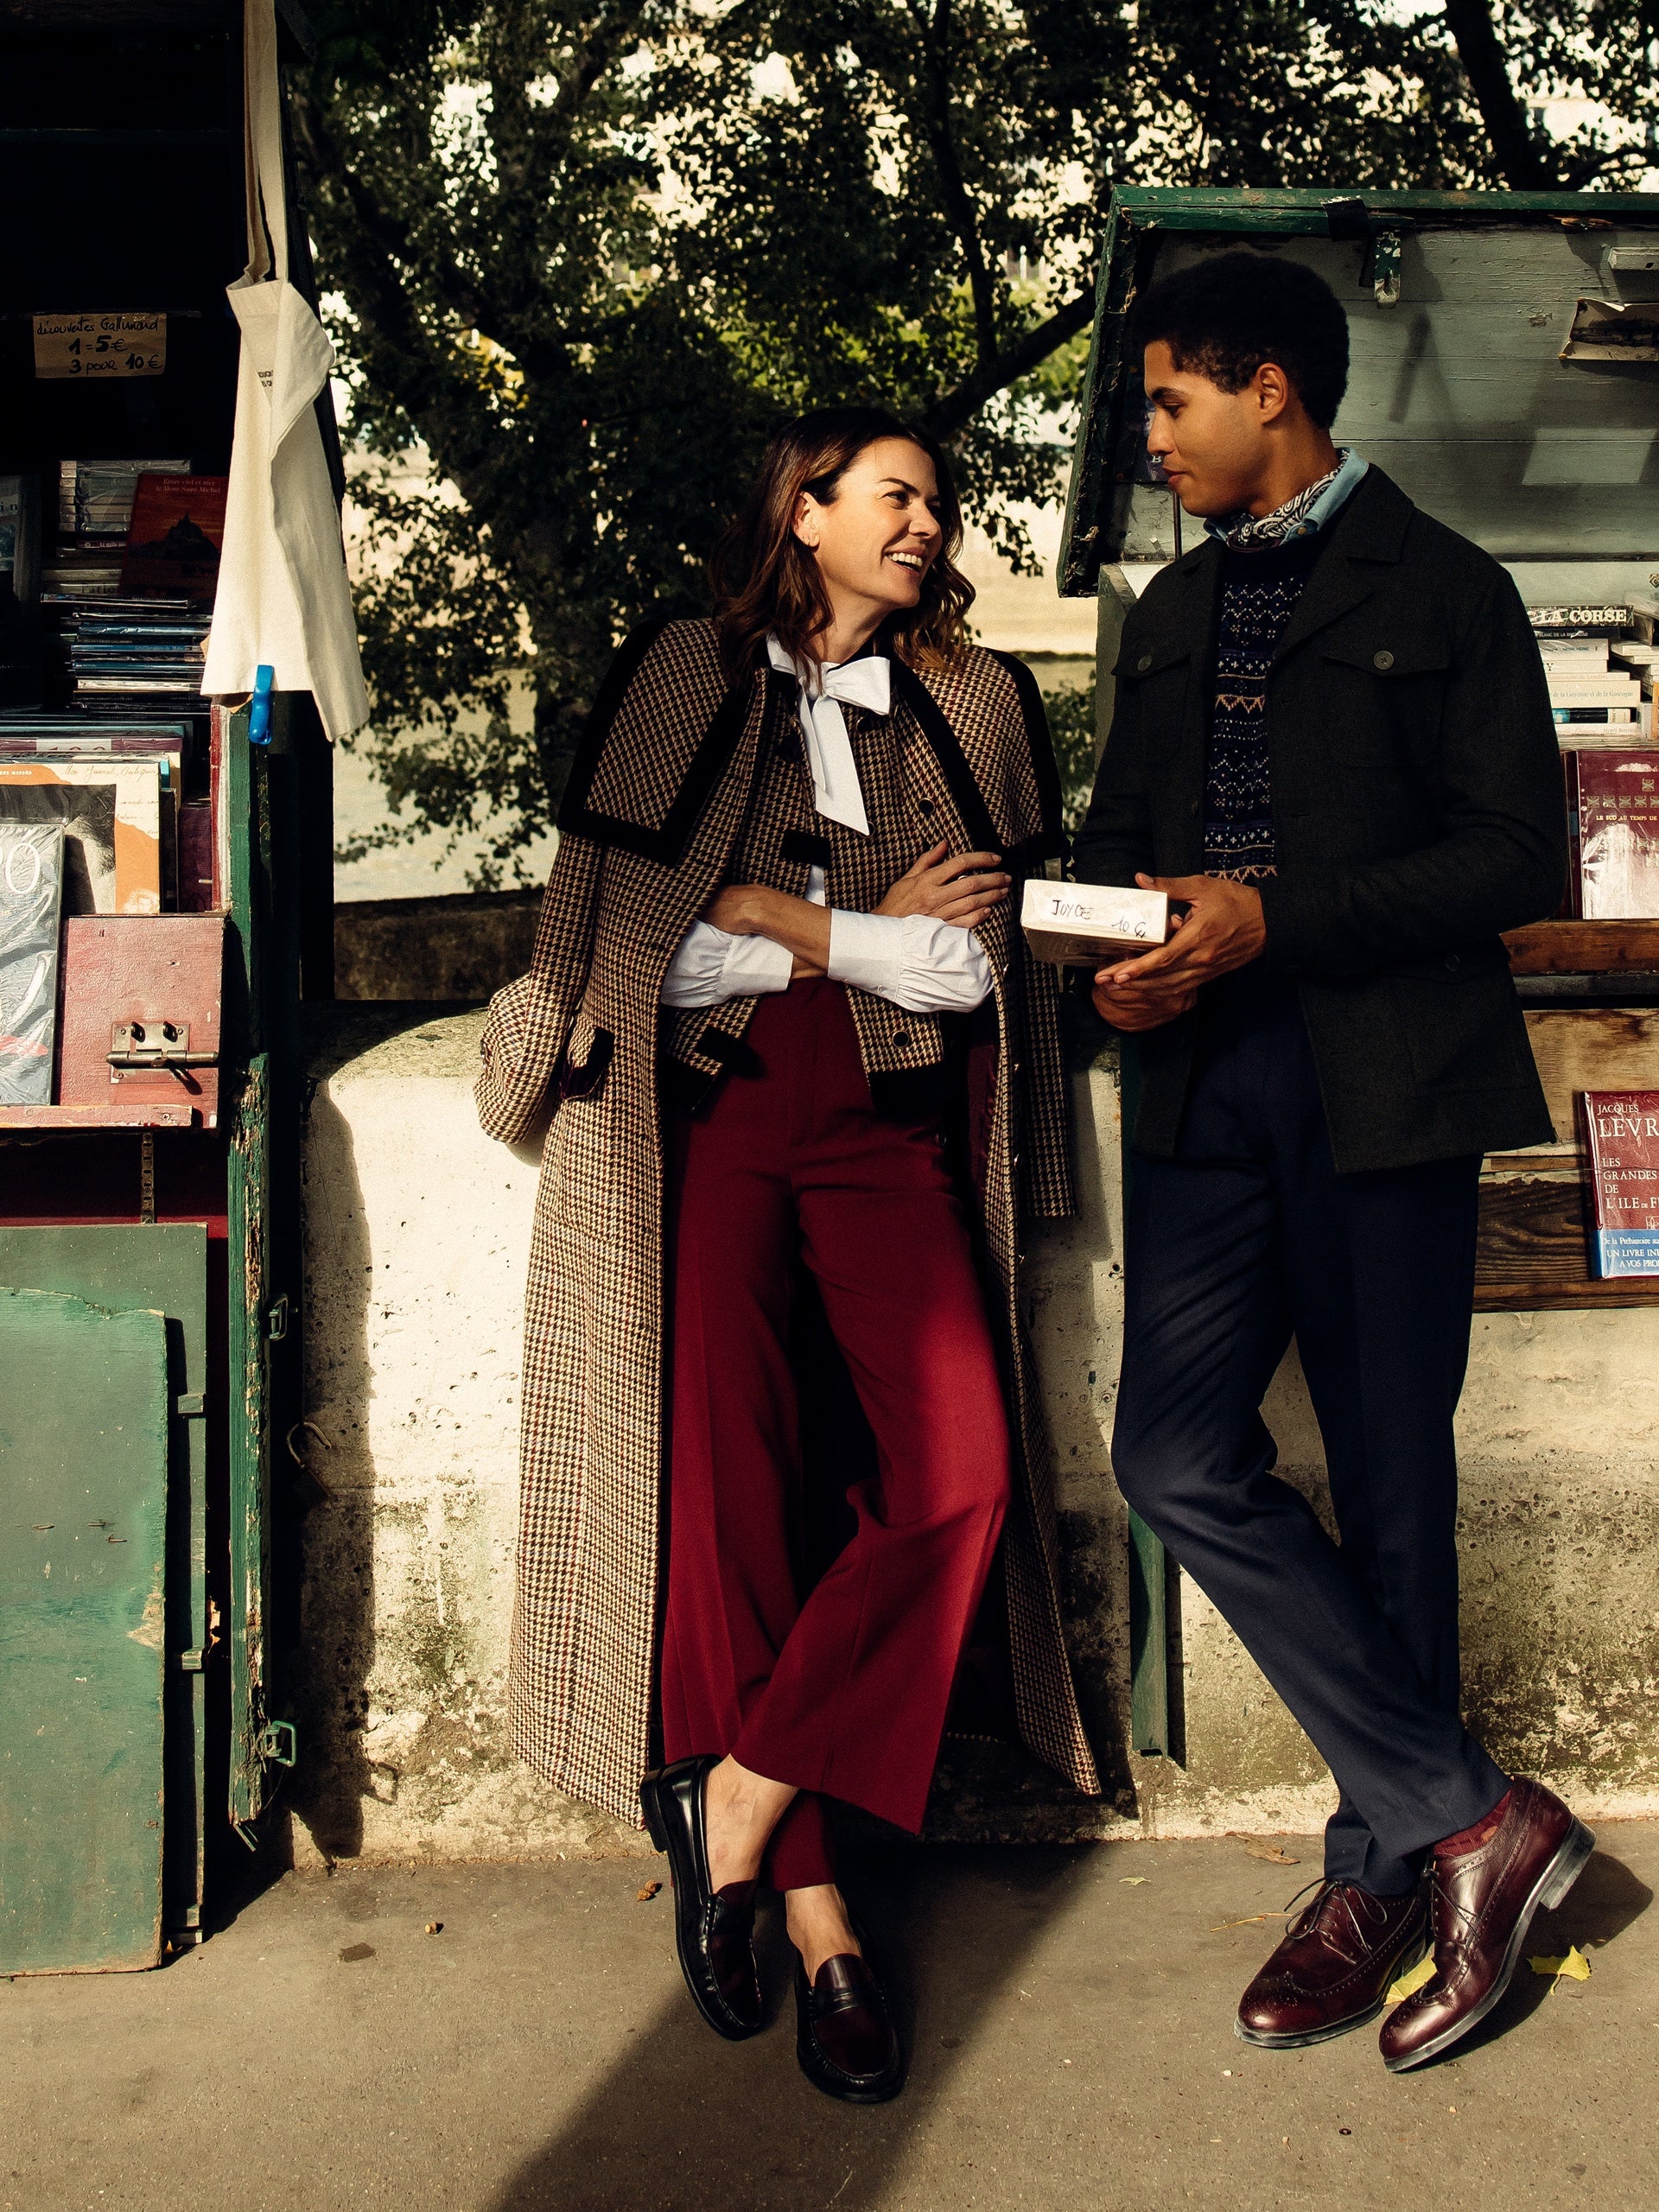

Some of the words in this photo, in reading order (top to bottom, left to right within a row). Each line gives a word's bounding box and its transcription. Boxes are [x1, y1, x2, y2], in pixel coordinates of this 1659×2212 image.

[68, 359, 82, 374] 3
[124, 353, 144, 369] 10
[147, 354, 162, 369] €
[1539, 610, 1564, 623] LA
[1569, 608, 1627, 623] CORSE
[1052, 899, 1094, 920] JOYCE
[1598, 1104, 1639, 1116] JACQUES
[1603, 1158, 1621, 1167] LES
[1604, 1171, 1657, 1180] GRANDES
[1605, 1185, 1618, 1193] DE
[1650, 1197, 1659, 1209] F
